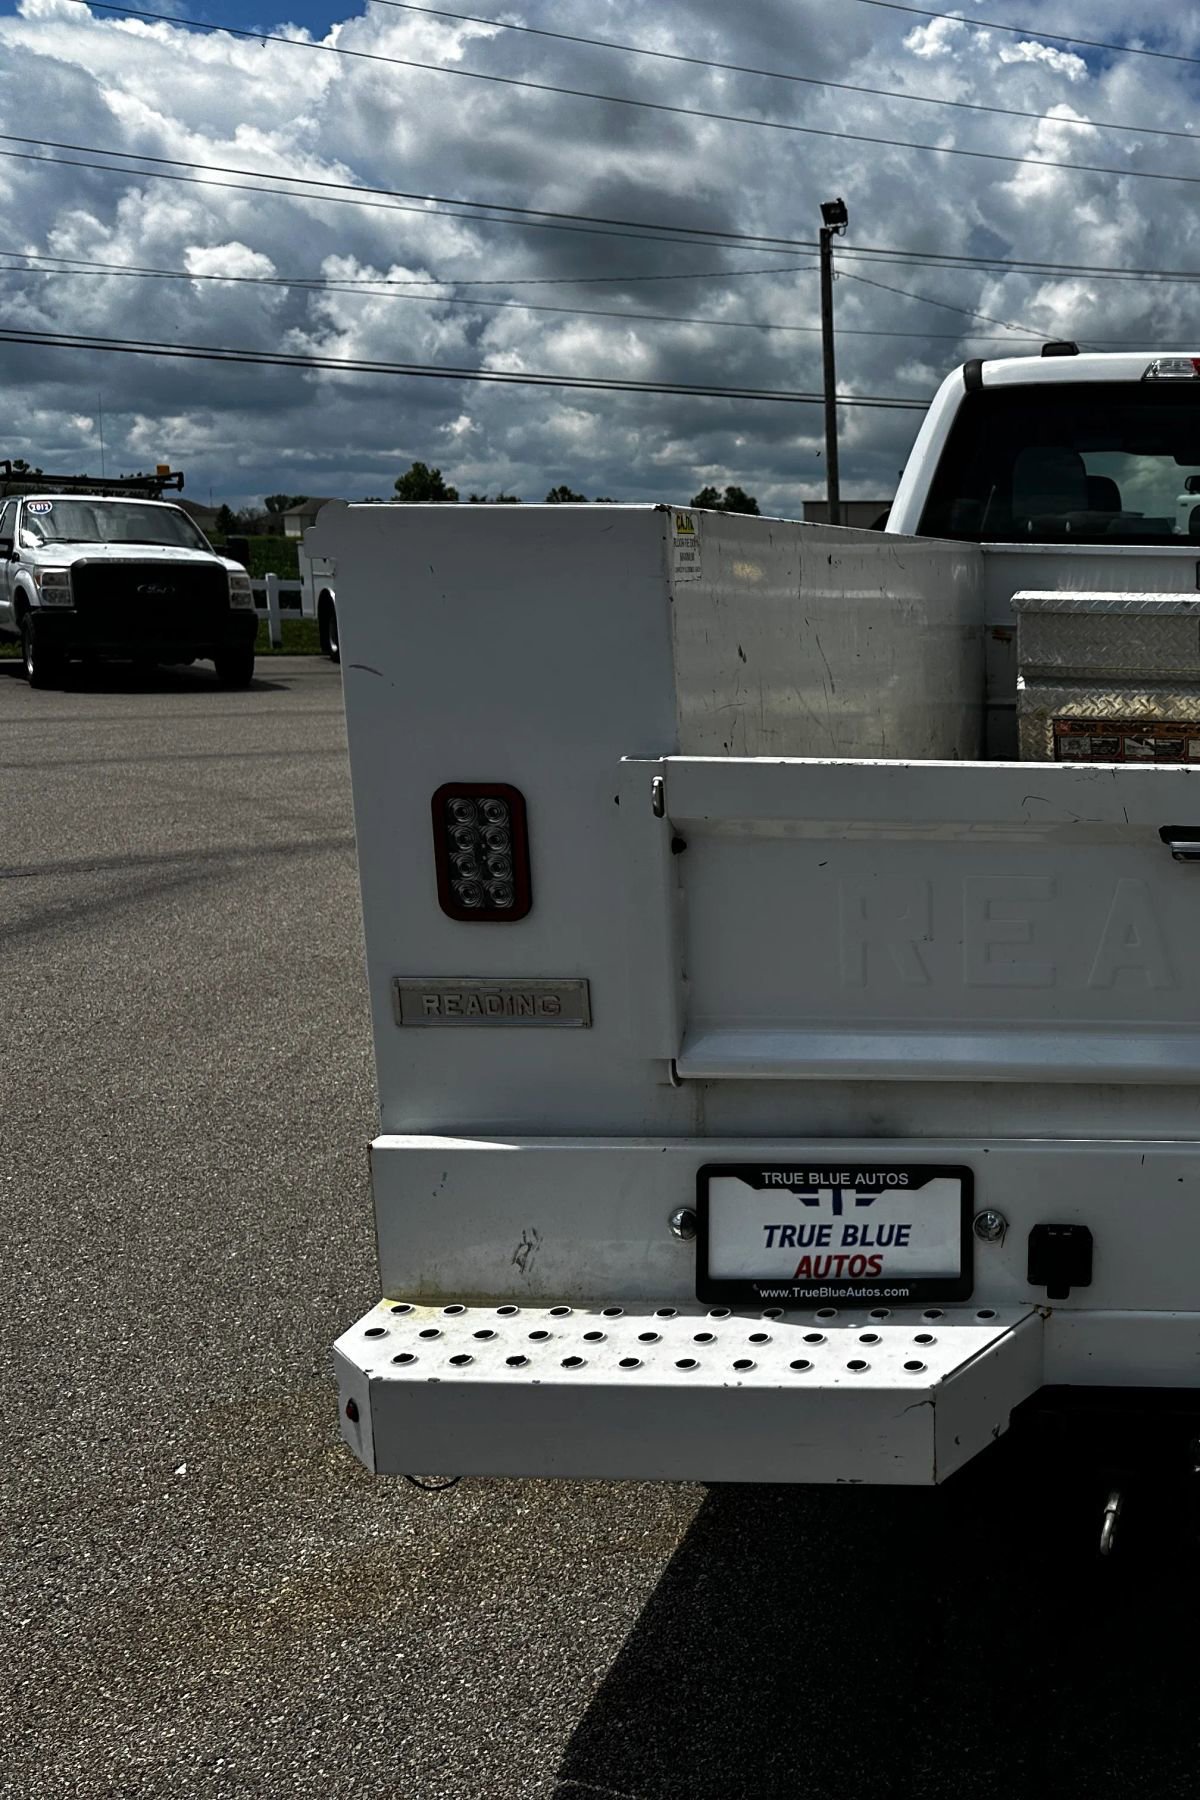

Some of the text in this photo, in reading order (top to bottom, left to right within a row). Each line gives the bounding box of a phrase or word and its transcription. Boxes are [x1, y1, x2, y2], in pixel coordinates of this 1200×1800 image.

[422, 994, 561, 1016] READING
[761, 1172, 909, 1185] TRUE BLUE AUTOS
[763, 1224, 913, 1249] TRUE BLUE
[793, 1254, 884, 1279] AUTOS
[759, 1286, 910, 1298] www.TrueBlueAutos.com
